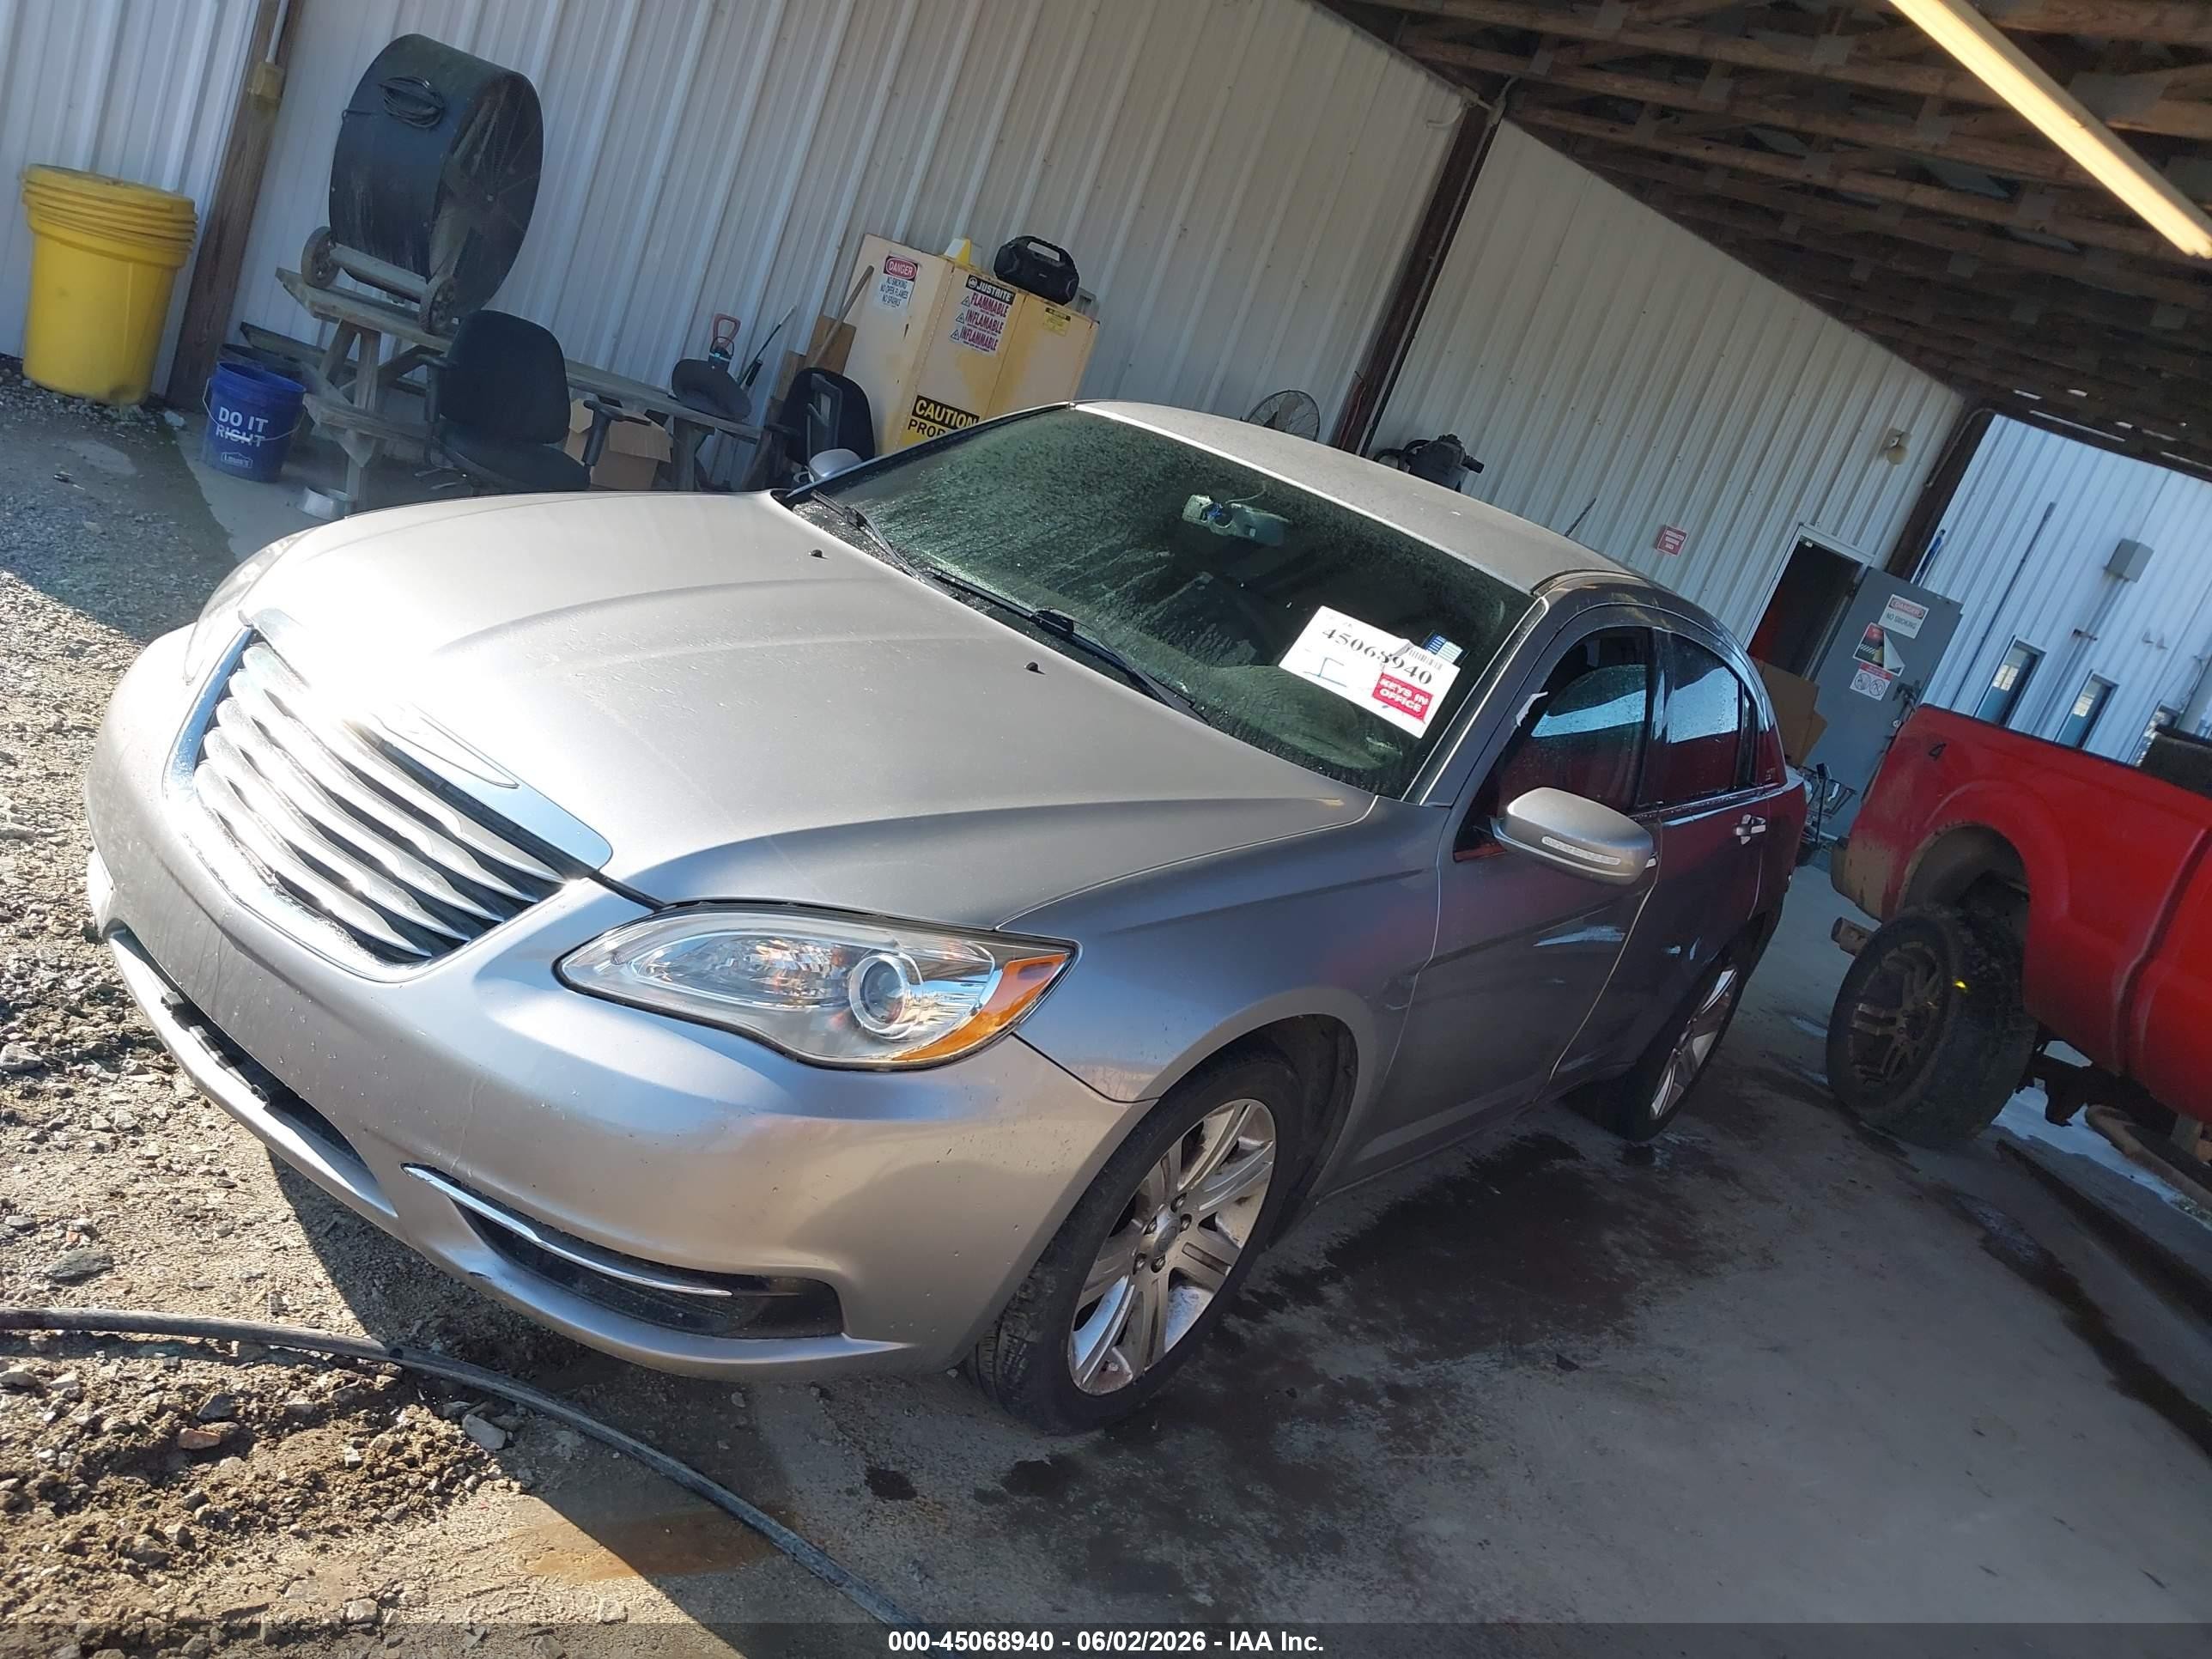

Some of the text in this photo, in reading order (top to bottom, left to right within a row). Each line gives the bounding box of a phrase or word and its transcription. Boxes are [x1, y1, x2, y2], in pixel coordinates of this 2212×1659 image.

[889, 260, 913, 276] DANGER
[976, 283, 1012, 301] JUSTRITE
[970, 292, 1009, 318] FLAMMABLE
[965, 309, 1004, 334] INFLAMABLE
[960, 326, 998, 350] INFLAMMABLE
[218, 406, 269, 433] DO IT
[915, 399, 978, 428] CAUTION
[216, 424, 265, 447] RIGHT
[1322, 629, 1432, 684] 45068940
[1379, 678, 1430, 706] KEYS IN
[1379, 688, 1423, 713] OFFICE
